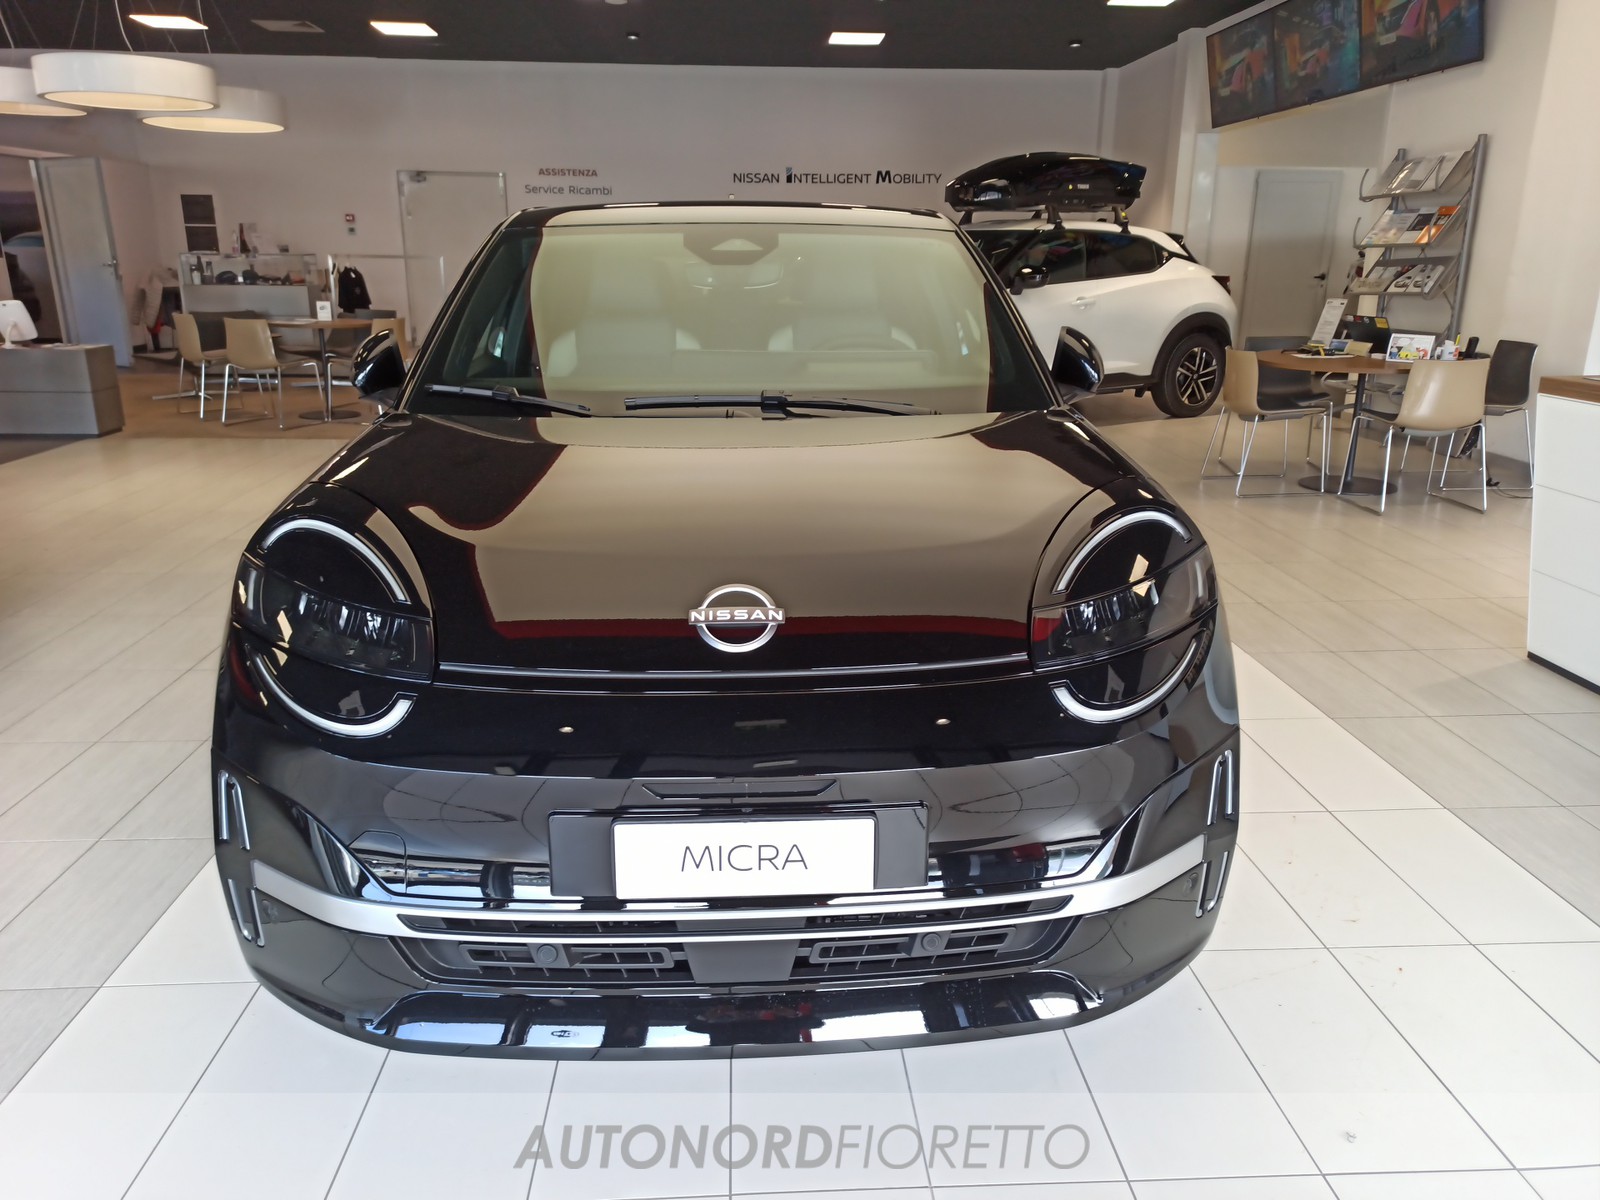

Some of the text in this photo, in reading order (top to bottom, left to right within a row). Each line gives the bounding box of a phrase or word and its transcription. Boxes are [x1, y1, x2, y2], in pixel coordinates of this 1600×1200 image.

[538, 167, 598, 177] ASSISTENZA
[733, 167, 942, 184] NISSAN INTELLIGENT MOBILITY
[524, 184, 613, 195] Service Ricambi
[690, 609, 783, 622] NISSAN
[681, 844, 808, 872] MICRA
